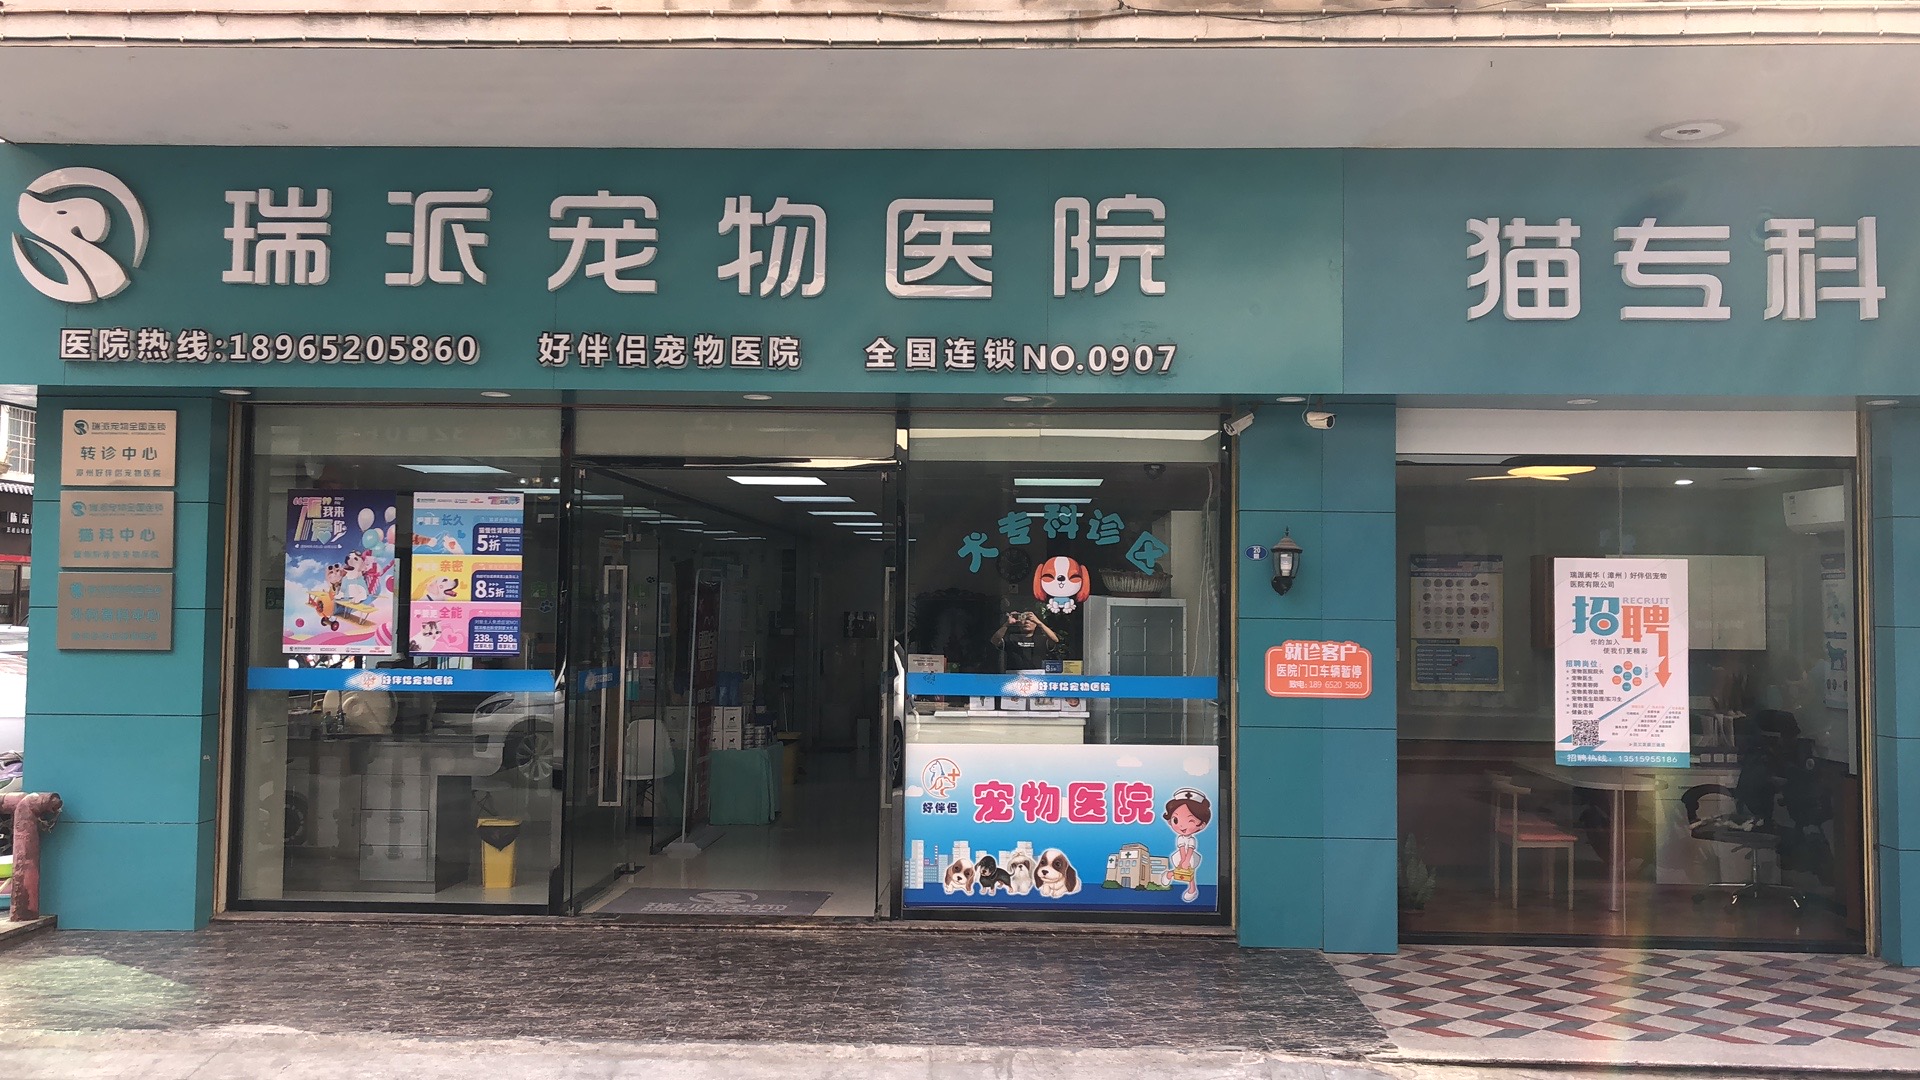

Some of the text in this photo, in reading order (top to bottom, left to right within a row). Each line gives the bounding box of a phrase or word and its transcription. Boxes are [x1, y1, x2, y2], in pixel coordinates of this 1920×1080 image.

[222, 186, 1167, 299] 瑞派宠物医院
[1467, 216, 1886, 322] 猫专科
[537, 332, 803, 369] 好伴侣宠物医院
[864, 335, 1177, 376] 全国连锁NO.0907
[80, 446, 158, 461] 转诊中心
[441, 514, 464, 526] 长久
[476, 535, 501, 552] 5折
[440, 560, 464, 573] 亲密
[475, 580, 505, 598] 8.5折
[1570, 580, 1615, 588] 医院有限公司
[1622, 597, 1670, 605] RECRUIT
[439, 606, 462, 619] 全能
[1572, 595, 1670, 650] 招聘
[1590, 638, 1620, 646] 你的加入
[1284, 643, 1358, 662] 就诊客户
[1276, 663, 1363, 679] 医院门口车辆暂停
[922, 802, 958, 814] 好伴侣
[972, 779, 1156, 825] 宠物医院
